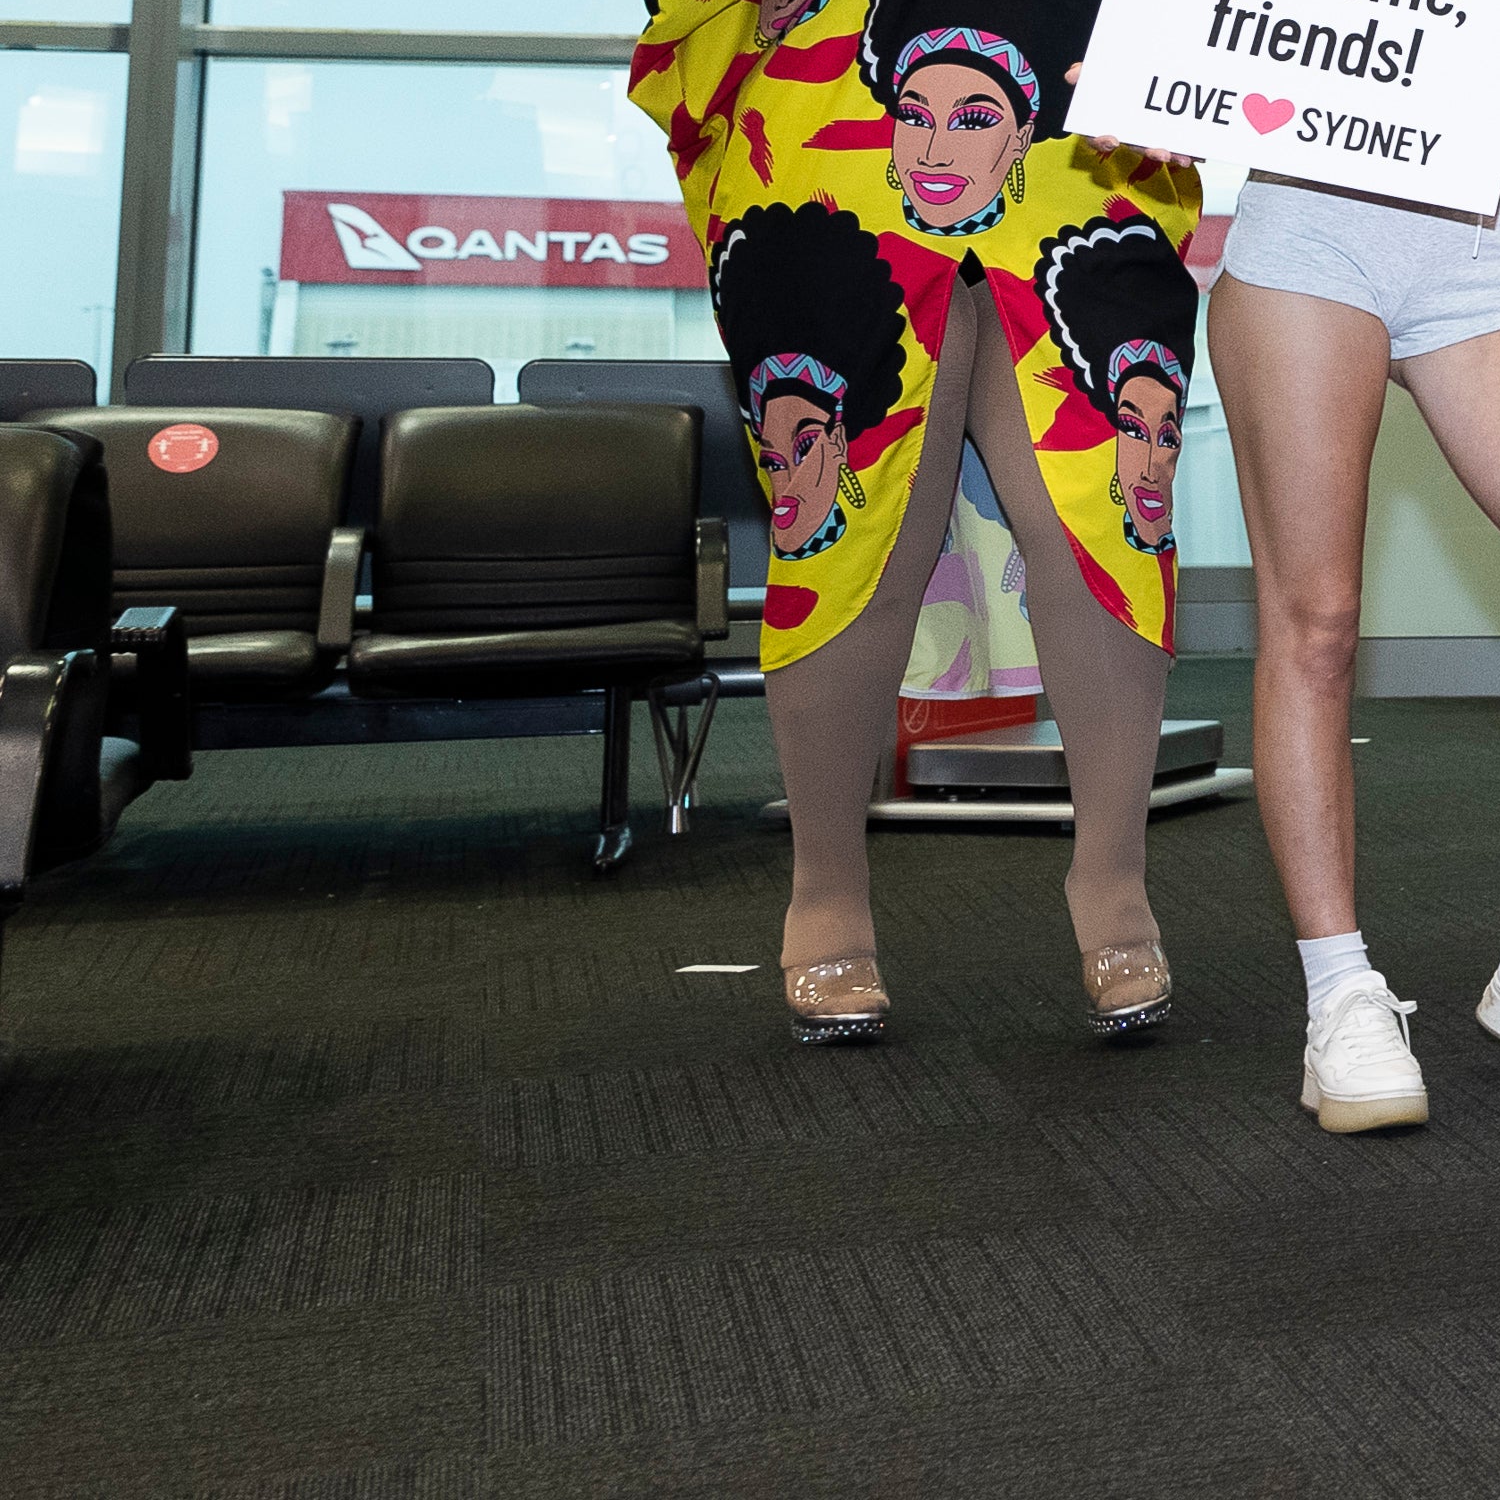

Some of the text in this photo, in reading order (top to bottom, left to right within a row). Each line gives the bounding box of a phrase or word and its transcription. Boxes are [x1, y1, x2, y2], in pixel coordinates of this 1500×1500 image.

[1144, 76, 1441, 165] LOVE SYDNEY
[406, 226, 669, 265] QANTAS
